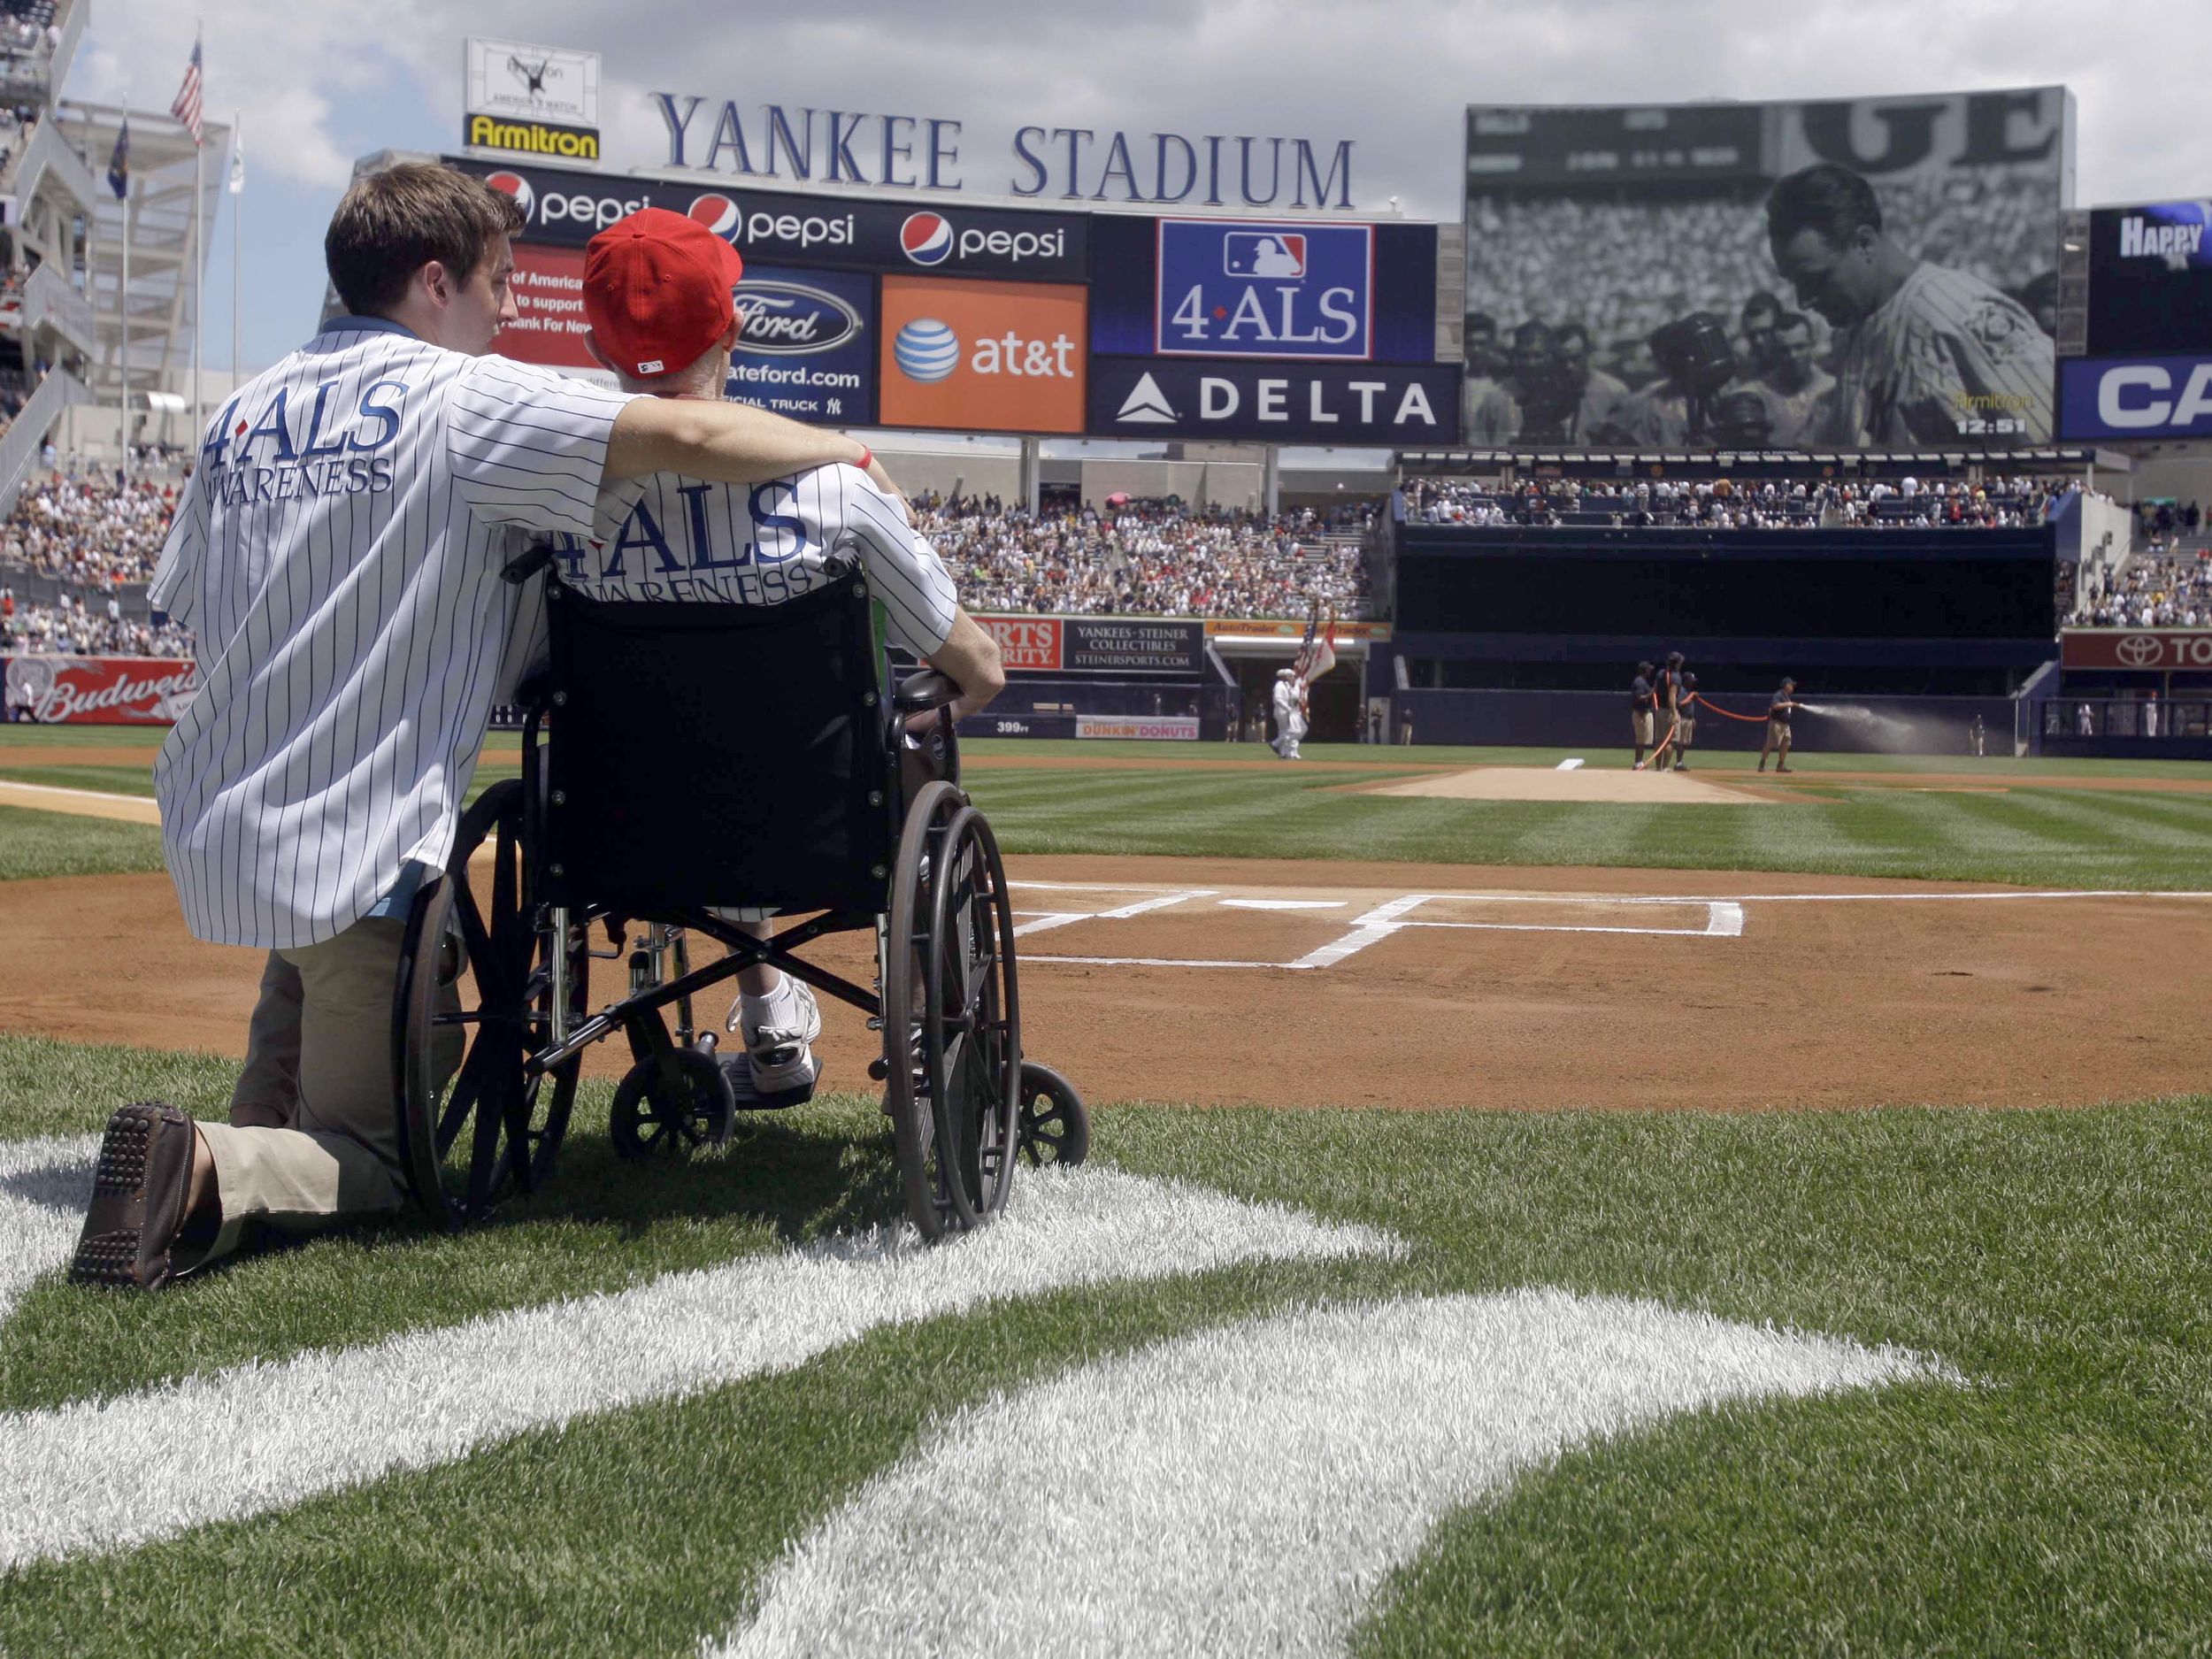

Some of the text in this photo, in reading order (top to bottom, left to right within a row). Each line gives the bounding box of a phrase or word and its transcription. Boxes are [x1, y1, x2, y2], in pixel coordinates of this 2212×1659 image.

[472, 116, 598, 158] Armitron
[648, 92, 1356, 211] YANKEE STADIUM
[748, 213, 855, 248] pepsi
[959, 227, 1064, 262] pepsi
[511, 271, 583, 290] of America
[517, 294, 584, 312] to support
[543, 318, 564, 332] For
[733, 294, 820, 341] Ford
[972, 331, 1074, 379] at&t
[770, 399, 818, 411] TRUCK
[1200, 377, 1436, 426] DELTA
[1955, 391, 2034, 411] Armitron
[2098, 365, 2212, 428] CA
[1955, 419, 2025, 434] 12:51
[1213, 622, 1276, 634] AutoTrader
[1089, 639, 1176, 651] COLLECTIBLES
[1075, 655, 1190, 666] STEINERSPORTS.COM
[1140, 725, 1197, 738] DONUTS
